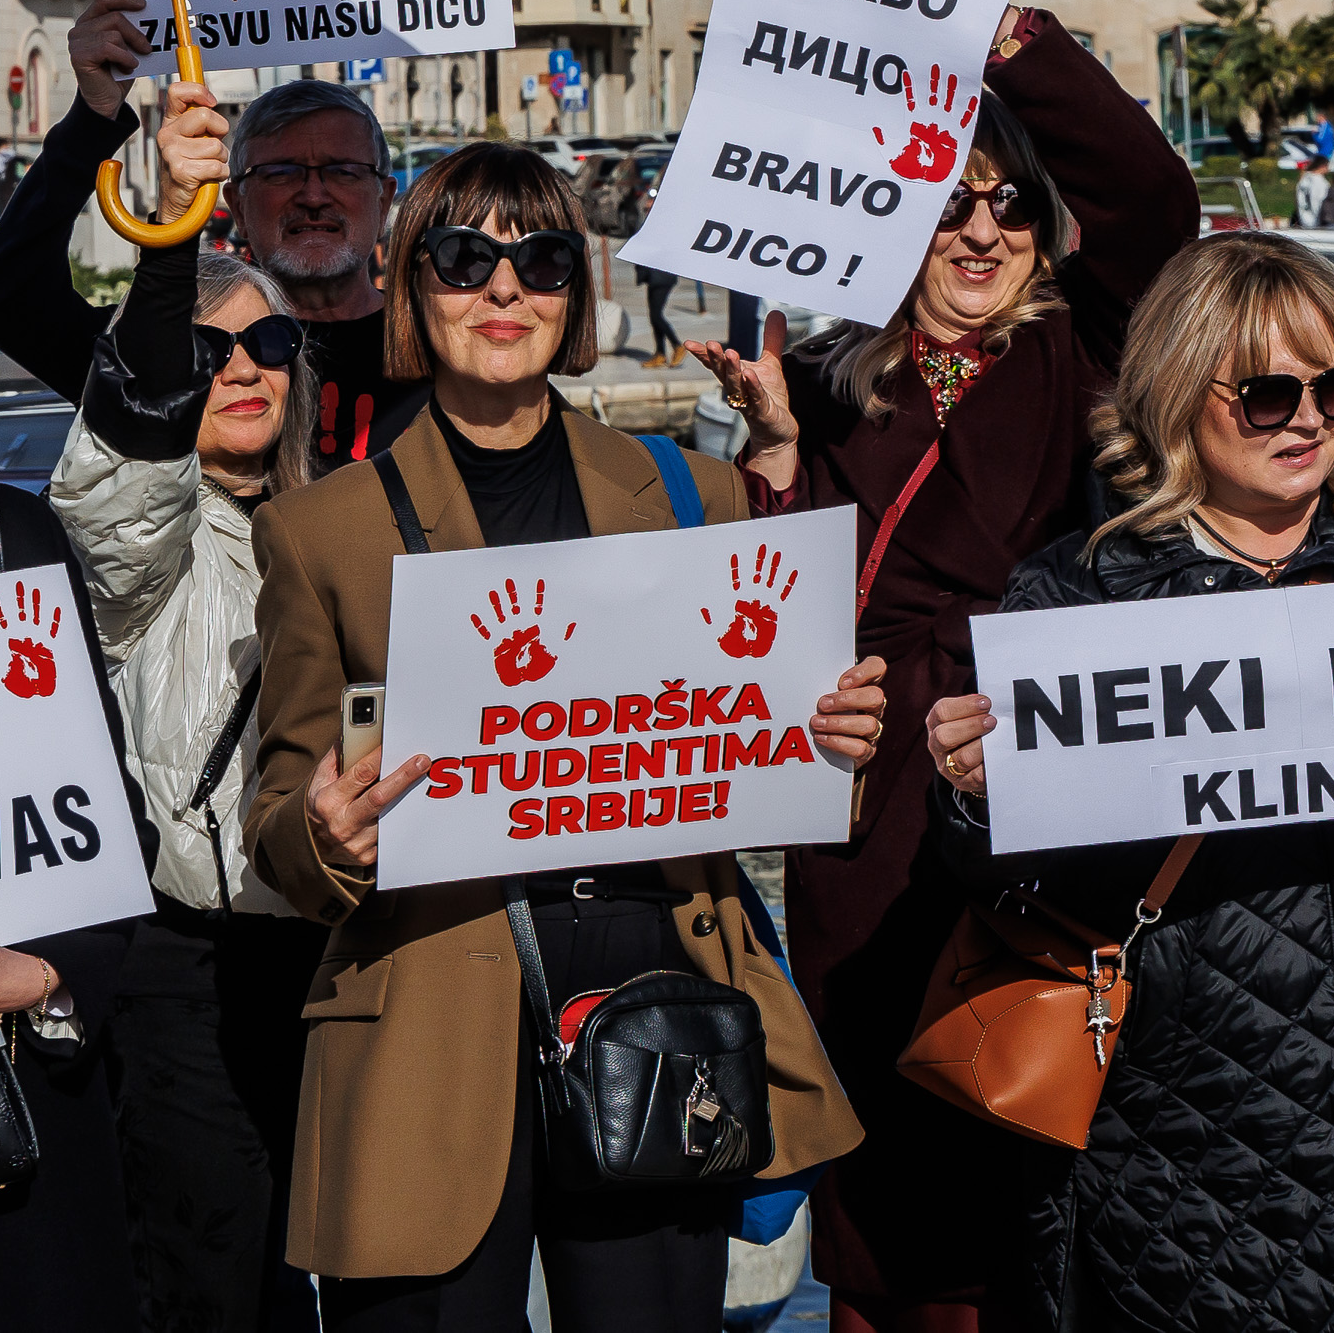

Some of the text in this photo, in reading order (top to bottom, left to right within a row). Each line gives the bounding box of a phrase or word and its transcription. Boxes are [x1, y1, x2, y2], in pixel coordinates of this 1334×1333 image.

[199, 10, 271, 50] SVU
[743, 21, 908, 96] ДИЦО
[712, 142, 901, 216] BRAVO
[691, 220, 826, 276] DICO
[479, 678, 772, 746] PODRŠKA
[1013, 658, 1265, 751] NEKI
[426, 725, 815, 799] STUDENTIMA
[508, 781, 730, 840] SRBIJE!
